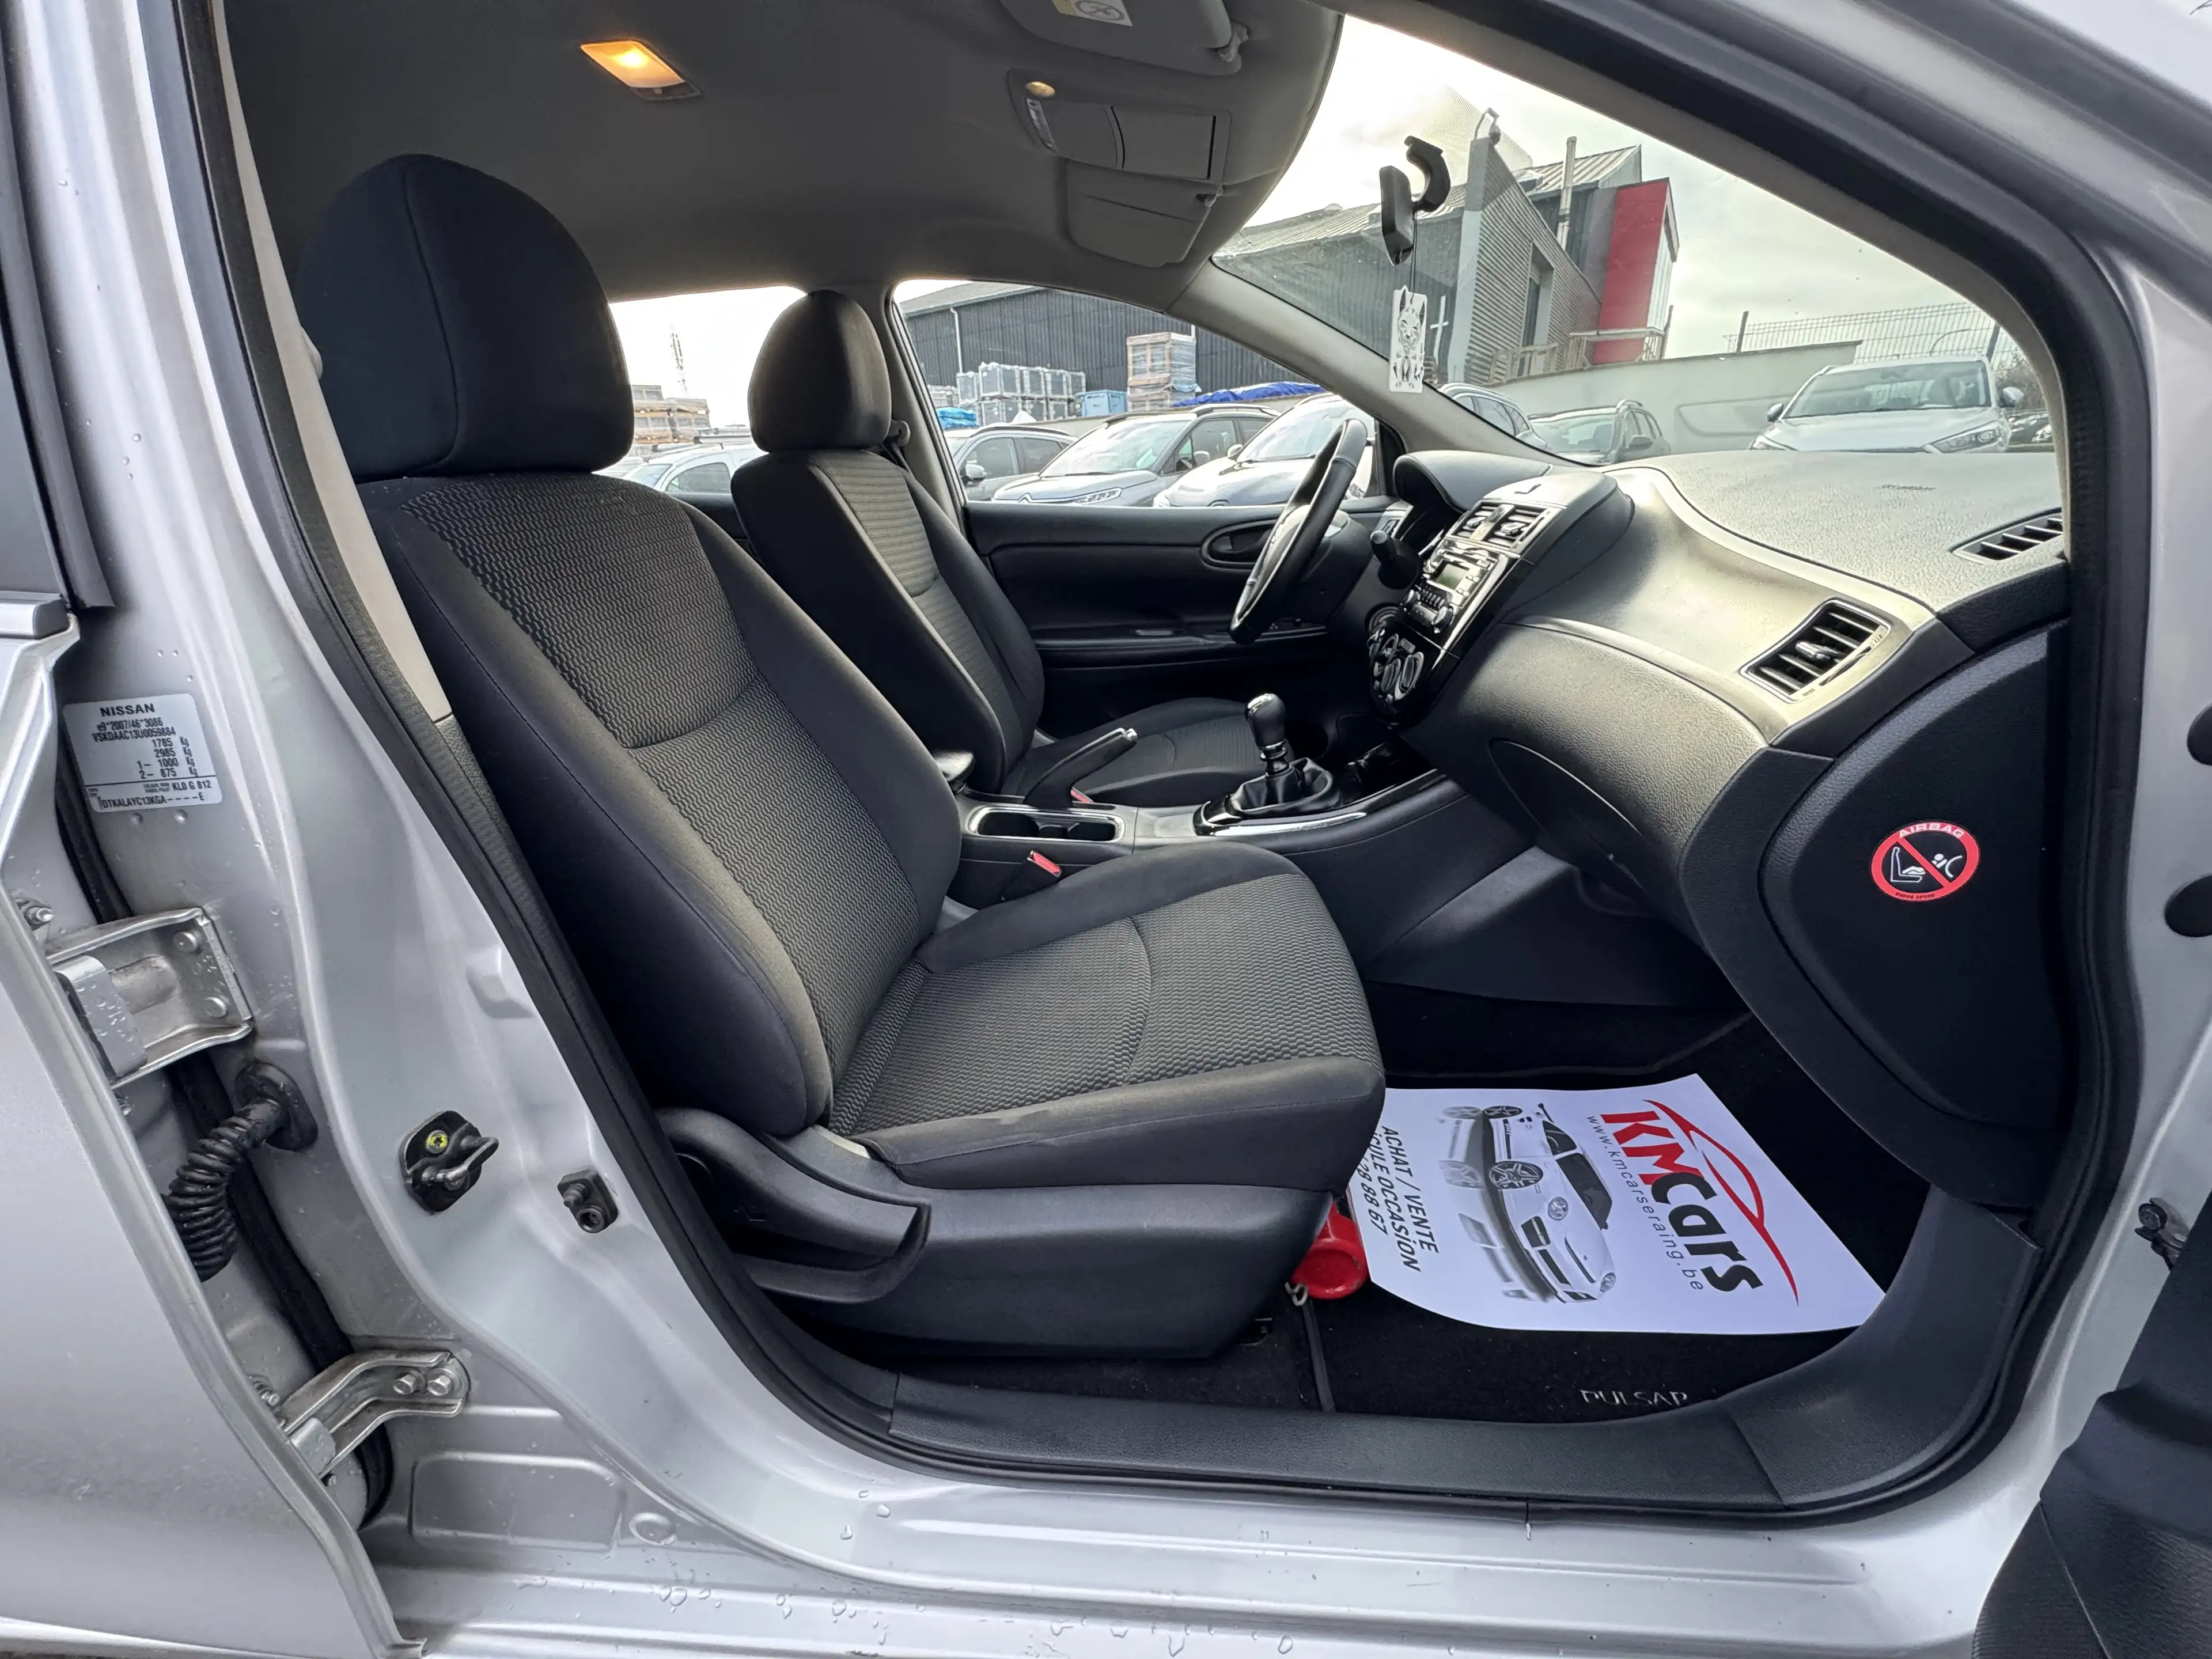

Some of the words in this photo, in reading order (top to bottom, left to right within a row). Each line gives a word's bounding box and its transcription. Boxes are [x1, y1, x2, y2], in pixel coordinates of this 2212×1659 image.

[100, 703, 155, 717] NISSAN
[151, 737, 173, 748] 1785
[179, 736, 190, 747] Kg
[154, 747, 176, 758] 2985
[182, 747, 192, 757] Kg
[157, 757, 179, 767] 1000
[185, 756, 195, 767] Kg
[160, 768, 177, 777] 875
[188, 766, 198, 777] Kg
[189, 781, 195, 790] G
[197, 780, 212, 790] 812
[1899, 823, 1965, 838] AIRBAG
[1361, 1182, 1380, 1208] 88
[1381, 1125, 1414, 1177] ACHAT
[1404, 1195, 1440, 1253] VENTE
[1586, 1115, 1704, 1290] www.kmcarseraing.be
[1600, 1111, 1764, 1291] KMCars
[1368, 1209, 1389, 1236] 67
